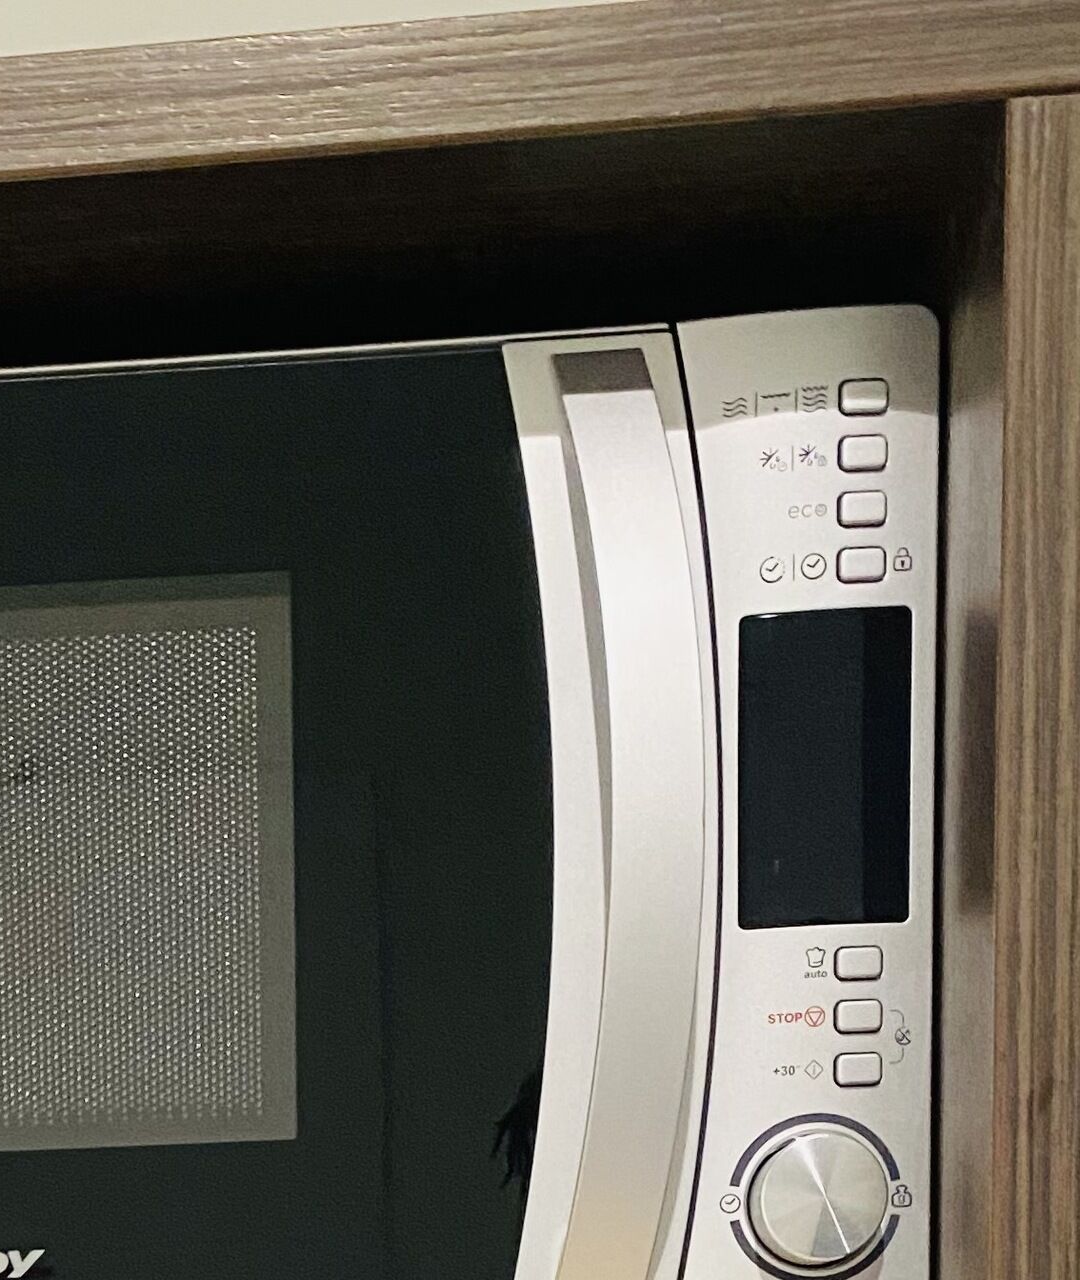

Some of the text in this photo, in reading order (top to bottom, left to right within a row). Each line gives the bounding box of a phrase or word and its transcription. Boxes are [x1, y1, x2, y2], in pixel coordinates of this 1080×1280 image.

[787, 502, 828, 519] eco
[804, 970, 828, 979] auto
[767, 1012, 803, 1024] STOP
